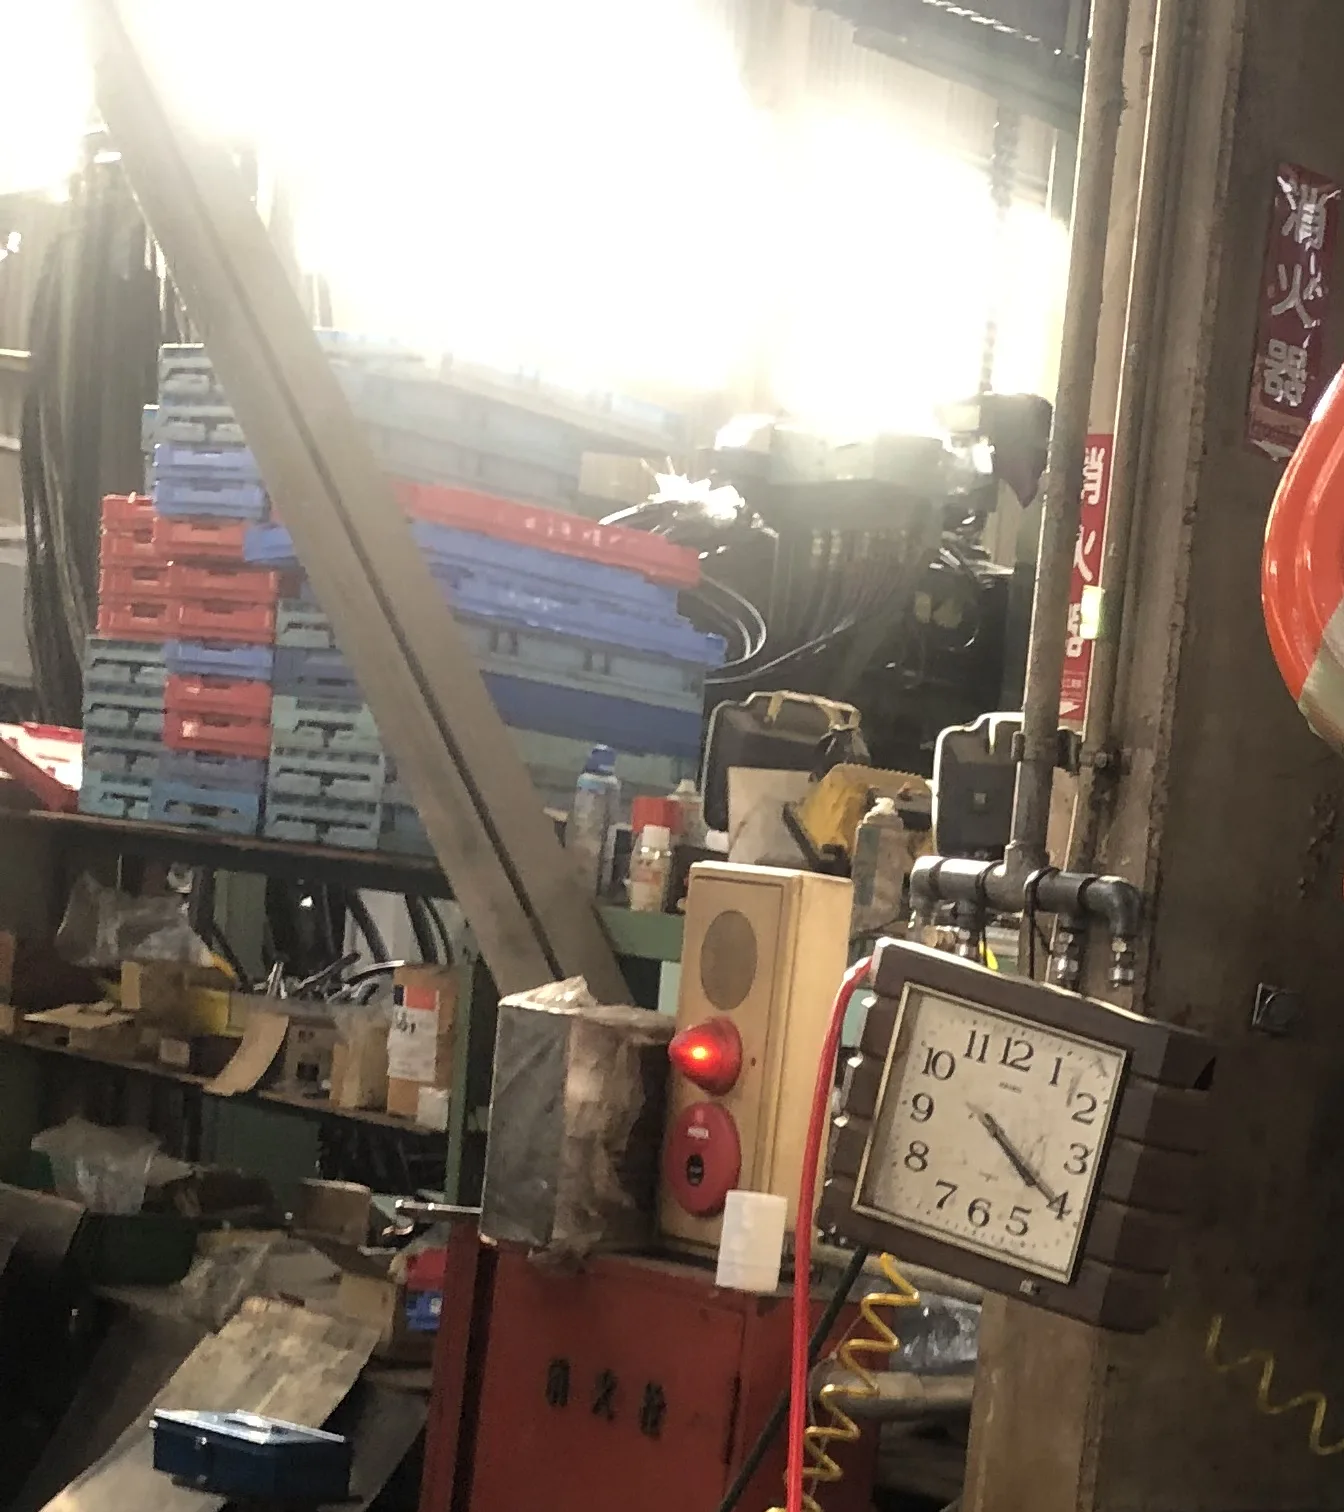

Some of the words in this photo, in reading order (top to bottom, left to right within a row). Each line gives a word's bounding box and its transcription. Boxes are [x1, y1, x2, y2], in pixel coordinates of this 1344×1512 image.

[1264, 177, 1339, 407] 消火器
[964, 1029, 989, 1065] 11
[1000, 1036, 1035, 1072] 12
[921, 1046, 957, 1082] 10
[1048, 1055, 1064, 1087] 1
[910, 1092, 935, 1123] 9
[1072, 1091, 1098, 1125] 2
[903, 1141, 930, 1172] 8
[1064, 1143, 1093, 1176] 3
[934, 1180, 959, 1211] 7
[1049, 1190, 1073, 1222] 4
[966, 1198, 991, 1229] 6
[1005, 1206, 1032, 1237] 5
